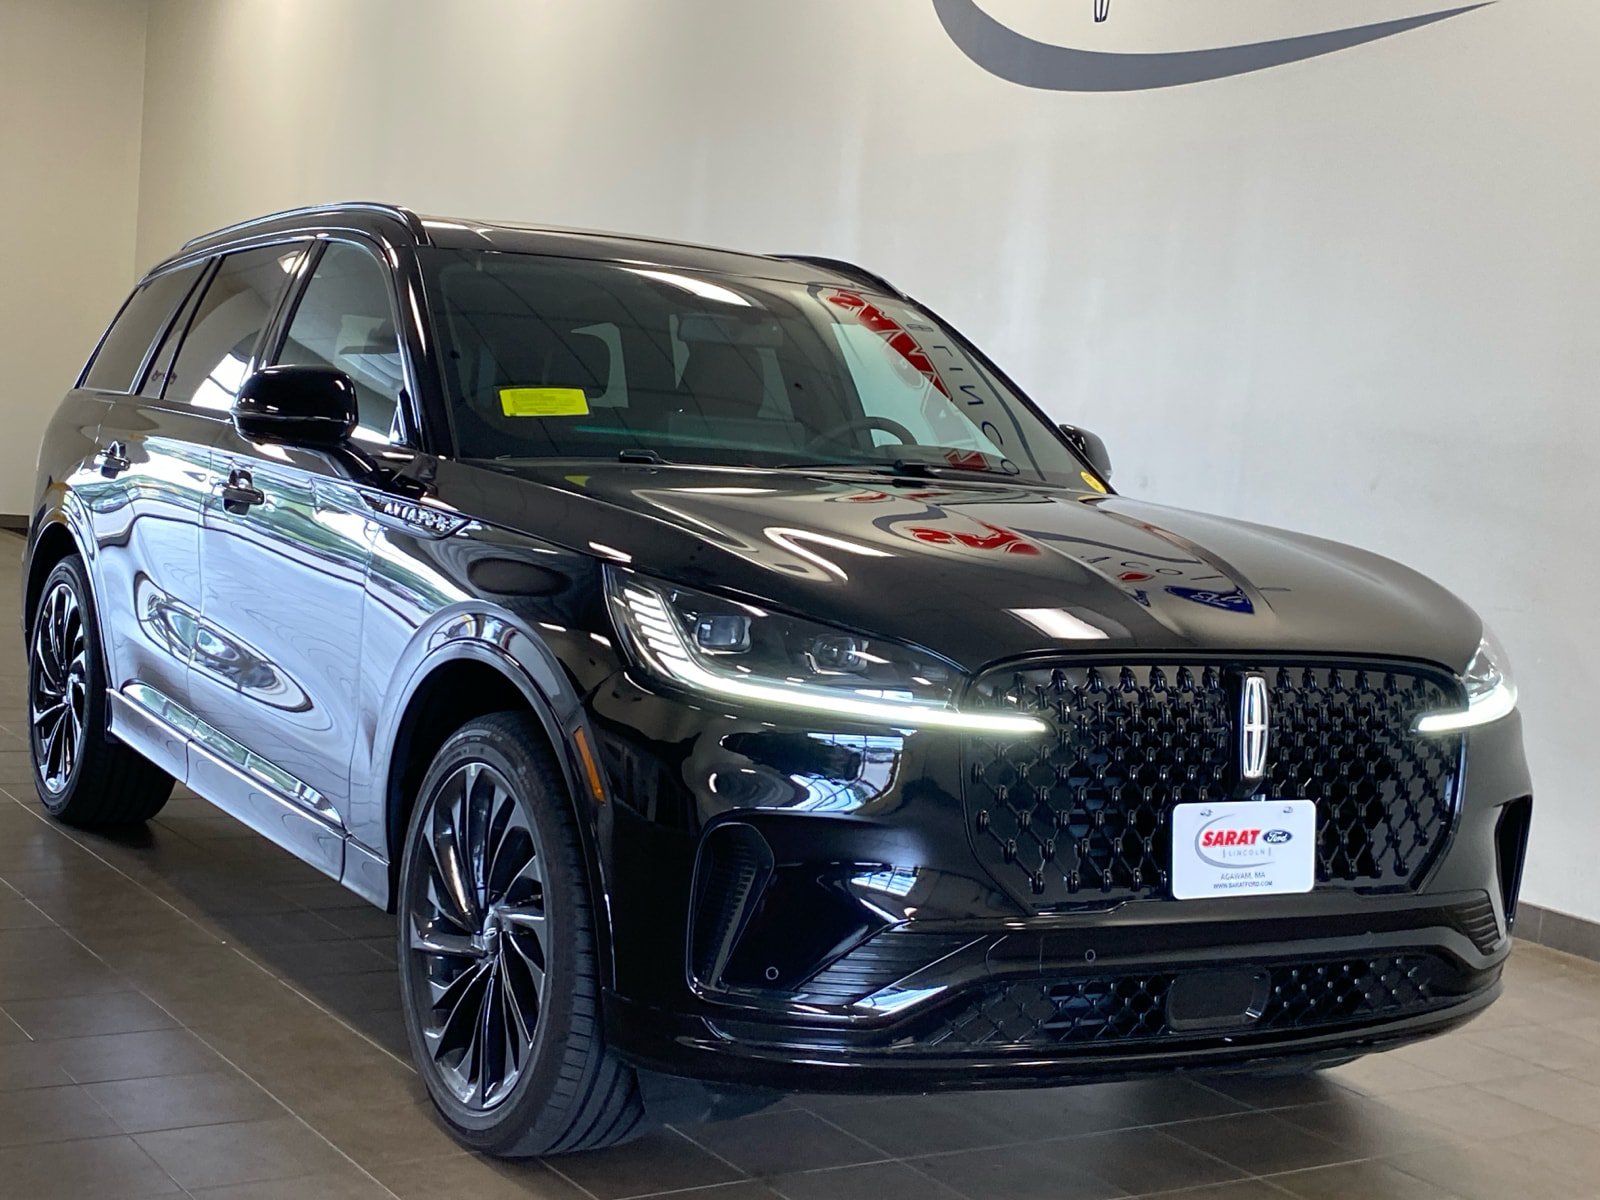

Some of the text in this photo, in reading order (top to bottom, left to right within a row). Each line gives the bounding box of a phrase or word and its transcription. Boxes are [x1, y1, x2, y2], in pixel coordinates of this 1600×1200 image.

[1202, 829, 1289, 847] SARAT Ford
[1228, 848, 1266, 857] LINCOLN
[1254, 871, 1266, 879] MA
